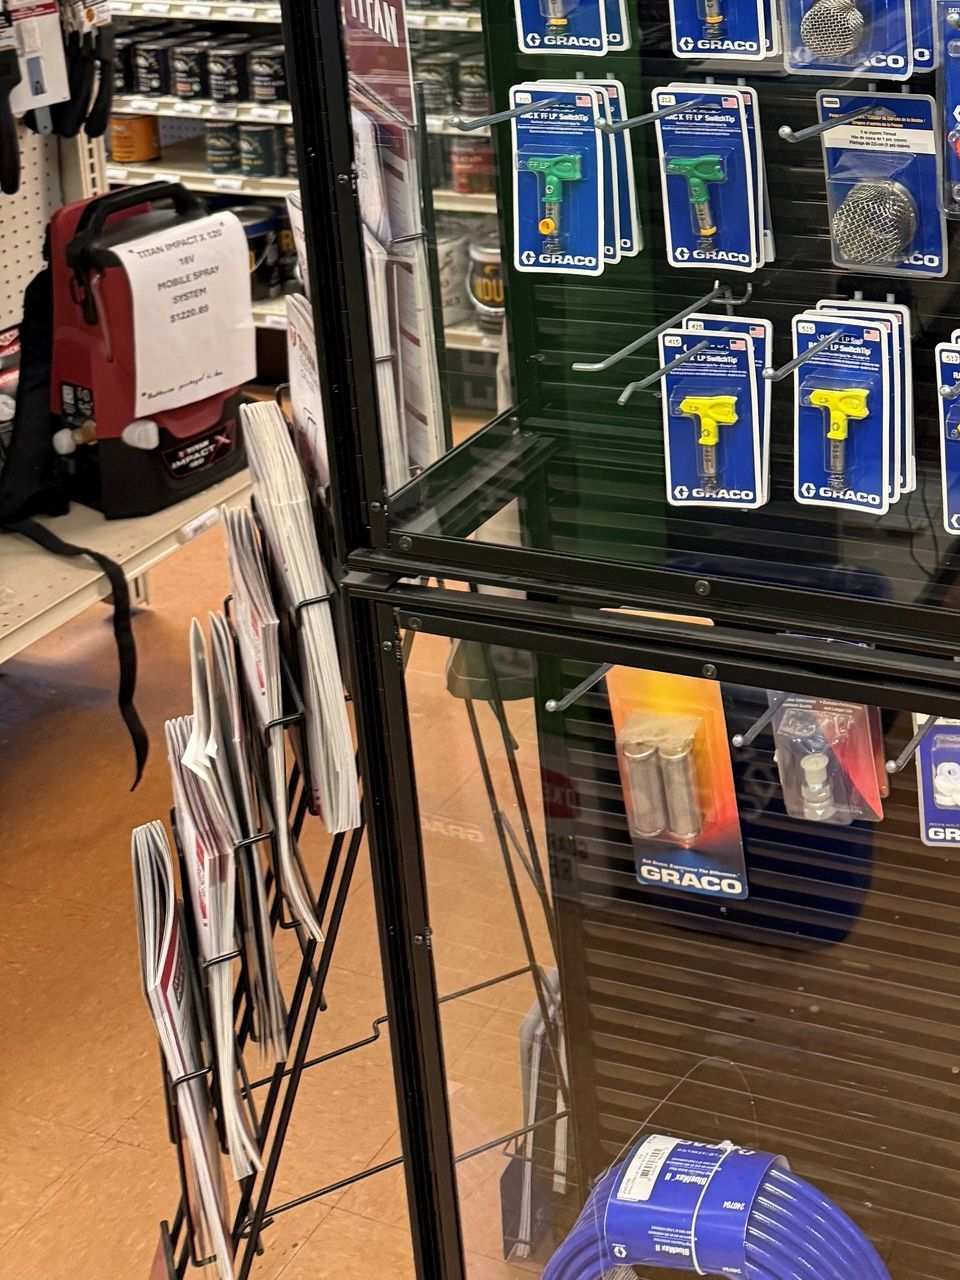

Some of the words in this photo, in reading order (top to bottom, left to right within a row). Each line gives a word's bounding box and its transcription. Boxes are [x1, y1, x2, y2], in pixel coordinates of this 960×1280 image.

[544, 35, 601, 48] GRACO
[698, 39, 758, 51] GRACO
[539, 255, 597, 266] GRACO
[693, 250, 750, 262] GRACO
[158, 274, 192, 291] MOBILE
[193, 266, 220, 282] SPRAY
[172, 287, 207, 304] SYSTEM
[692, 489, 754, 500] GRACO
[819, 487, 881, 505] GRACO
[641, 865, 742, 894] GRACO
